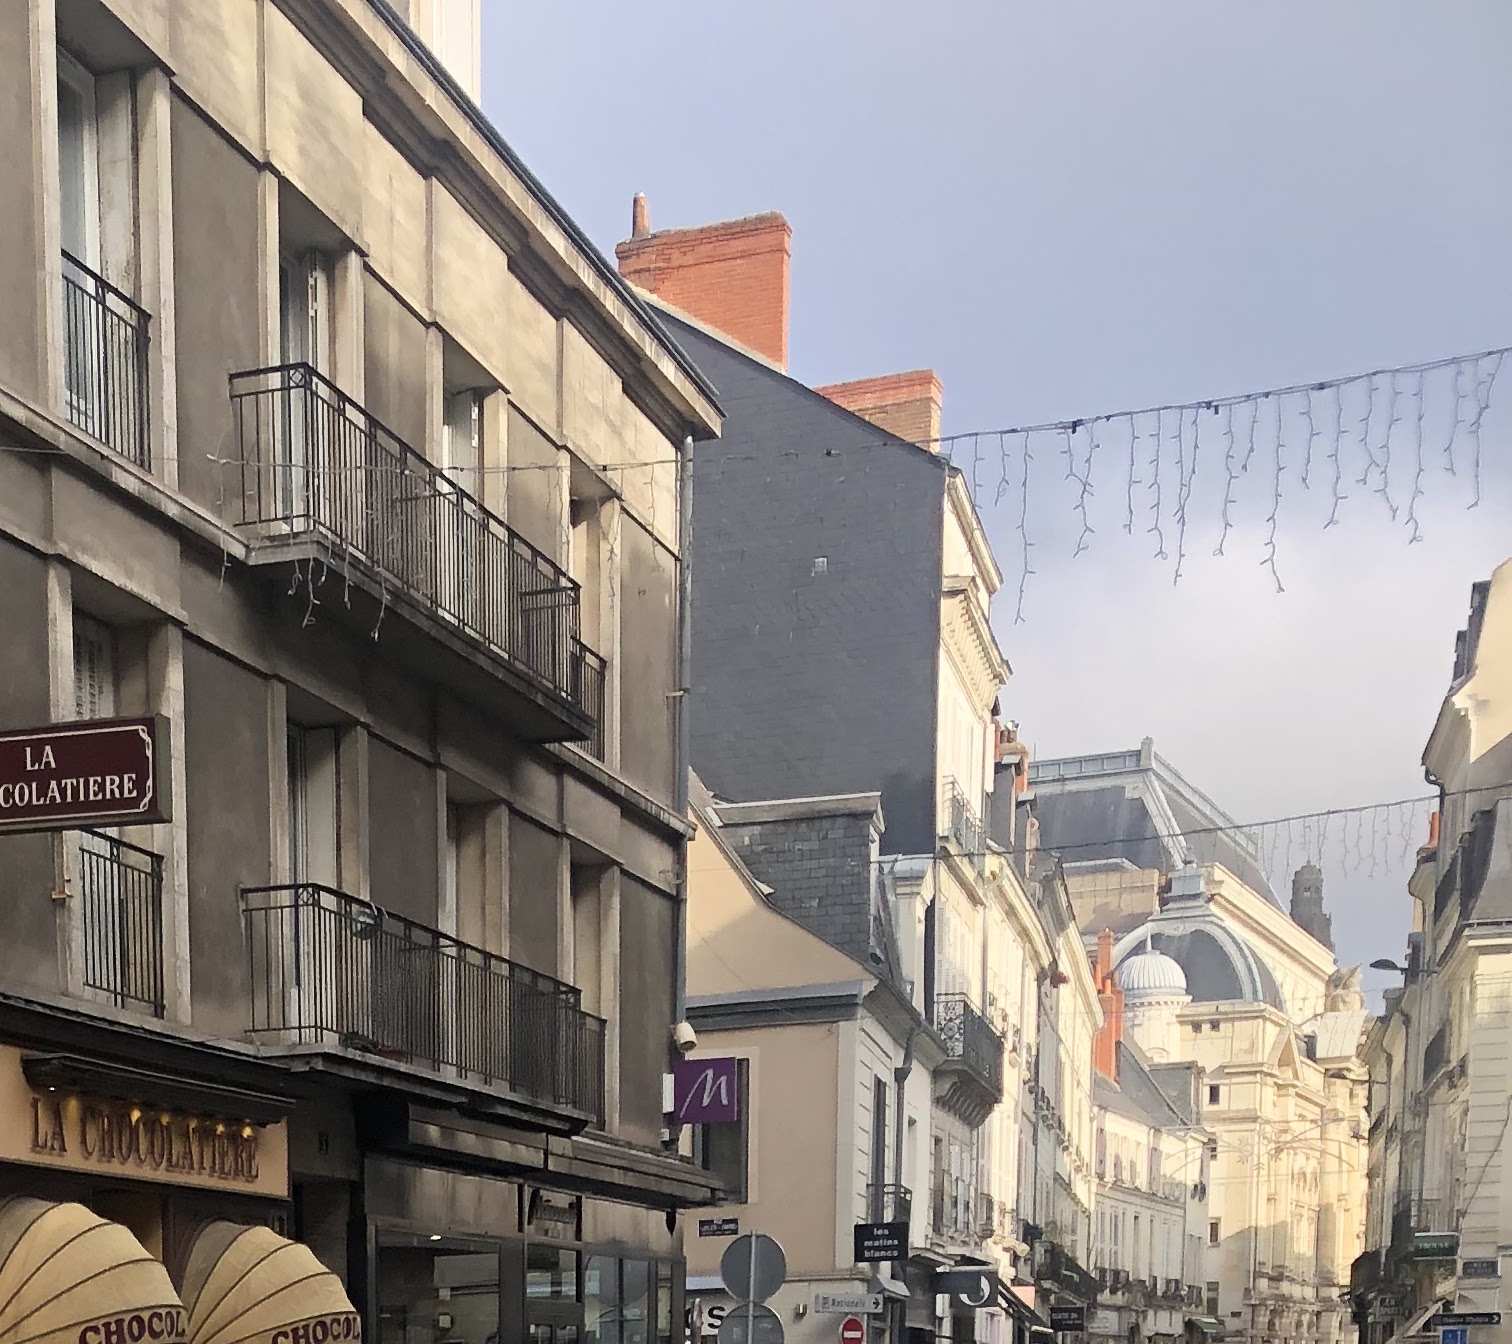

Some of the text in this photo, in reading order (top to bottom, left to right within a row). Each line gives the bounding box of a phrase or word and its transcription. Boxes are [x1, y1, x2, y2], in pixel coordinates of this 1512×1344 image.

[25, 745, 57, 771] LA
[30, 1097, 68, 1155] LA
[873, 1227, 890, 1236] les
